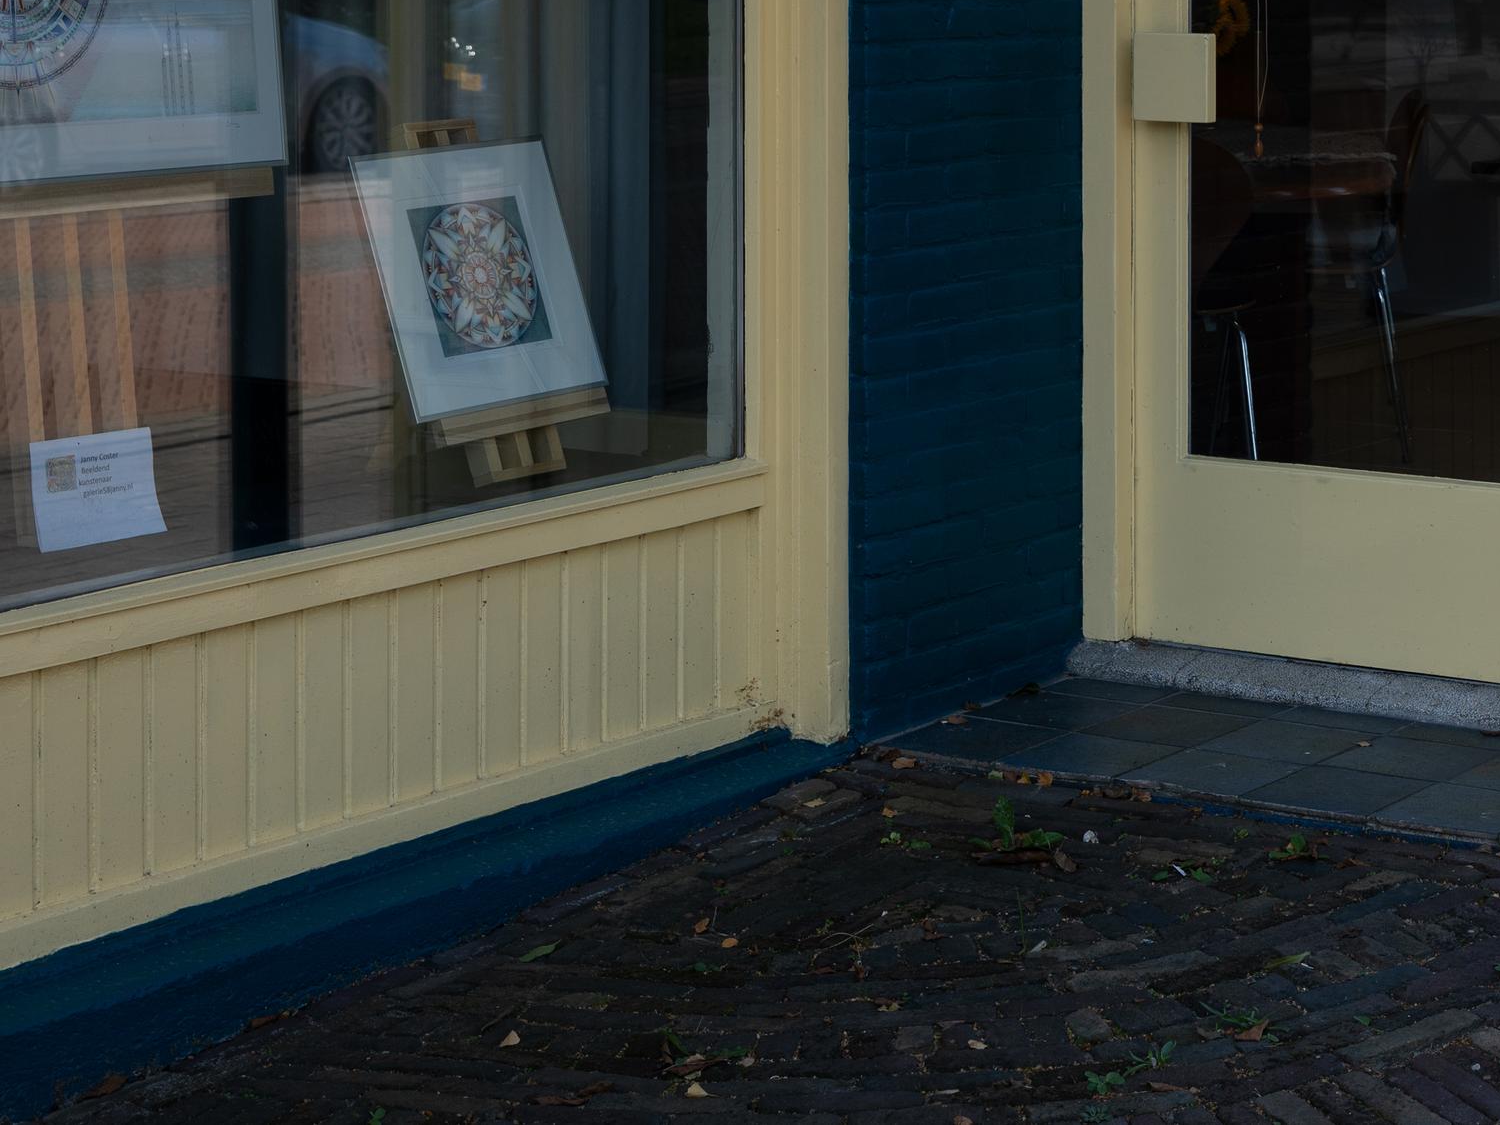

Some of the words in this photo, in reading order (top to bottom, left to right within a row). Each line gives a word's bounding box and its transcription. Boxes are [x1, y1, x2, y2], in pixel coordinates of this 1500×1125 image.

[80, 455, 98, 464] Janny
[99, 452, 119, 461] Coster
[81, 464, 110, 474] Beeldend
[78, 475, 112, 486] kunstenaar
